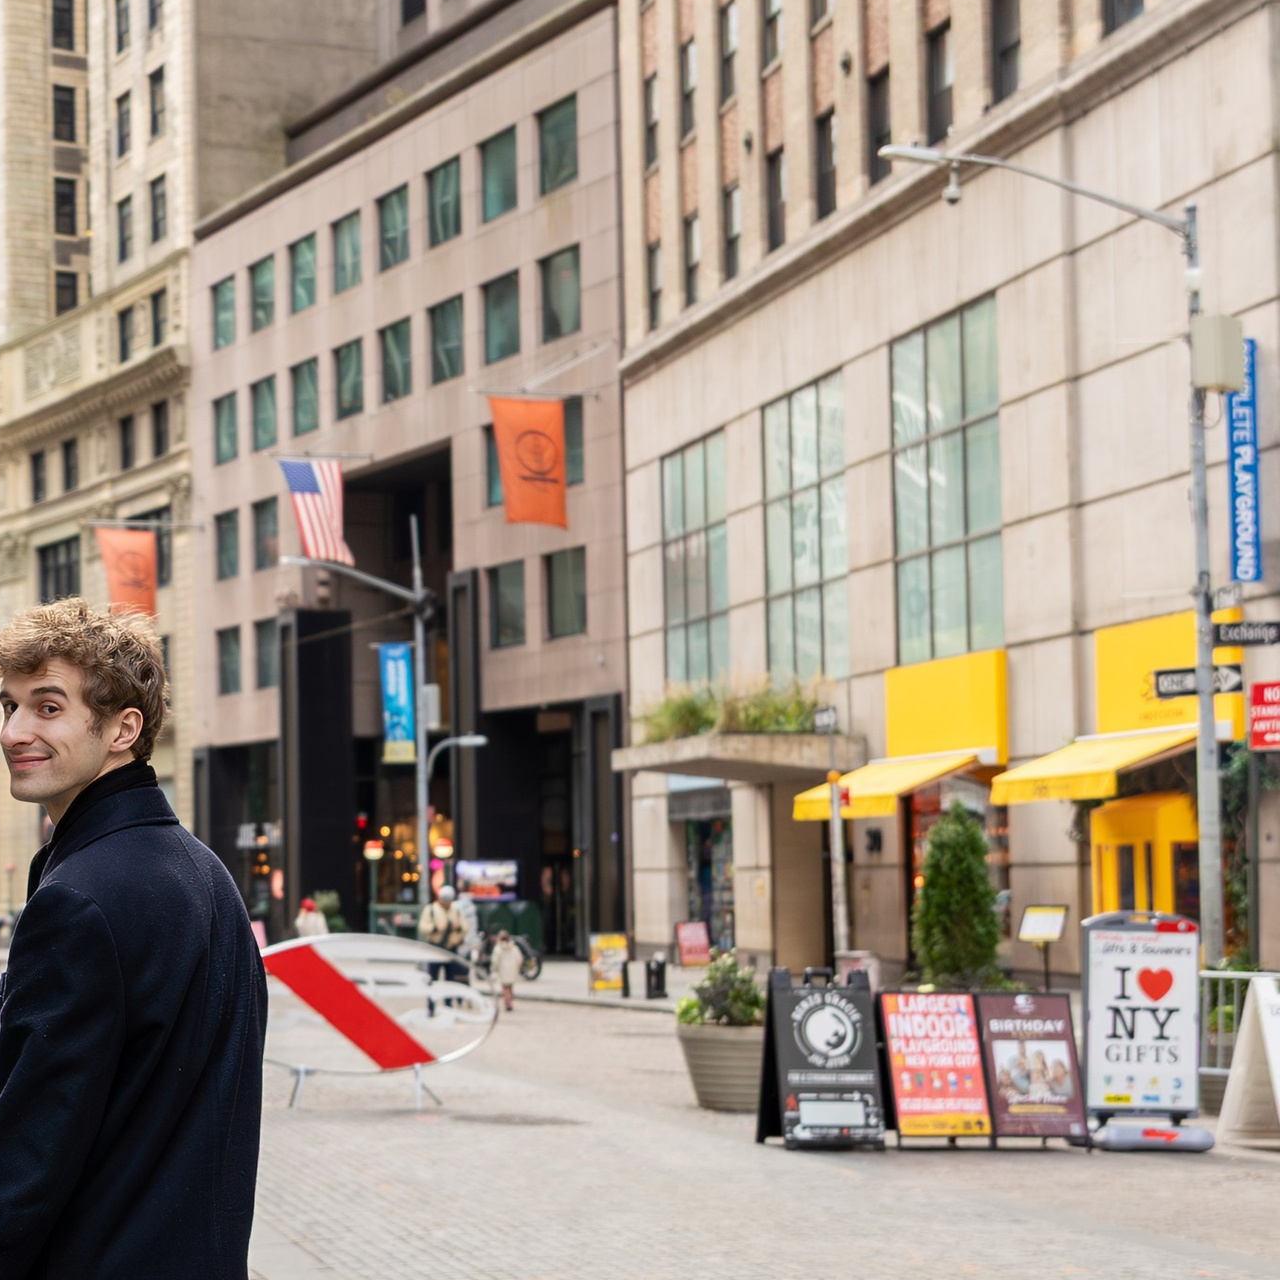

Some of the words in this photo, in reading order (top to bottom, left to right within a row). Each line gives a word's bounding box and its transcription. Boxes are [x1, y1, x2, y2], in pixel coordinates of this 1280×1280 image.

[1233, 446, 1257, 581] PLAYGROUND
[1220, 625, 1278, 643] Exchange
[1160, 675, 1188, 690] ONE
[1114, 966, 1132, 1001] I
[897, 995, 968, 1013] LARGEST
[888, 1014, 971, 1038] INDOOR
[989, 1019, 1065, 1032] BIRTHDAY
[1105, 1005, 1181, 1041] NY
[891, 1038, 978, 1054] PLAYGROUND
[1105, 1044, 1180, 1065] GIFTS
[928, 1054, 954, 1067] YORK
[954, 1053, 979, 1067] CITY
